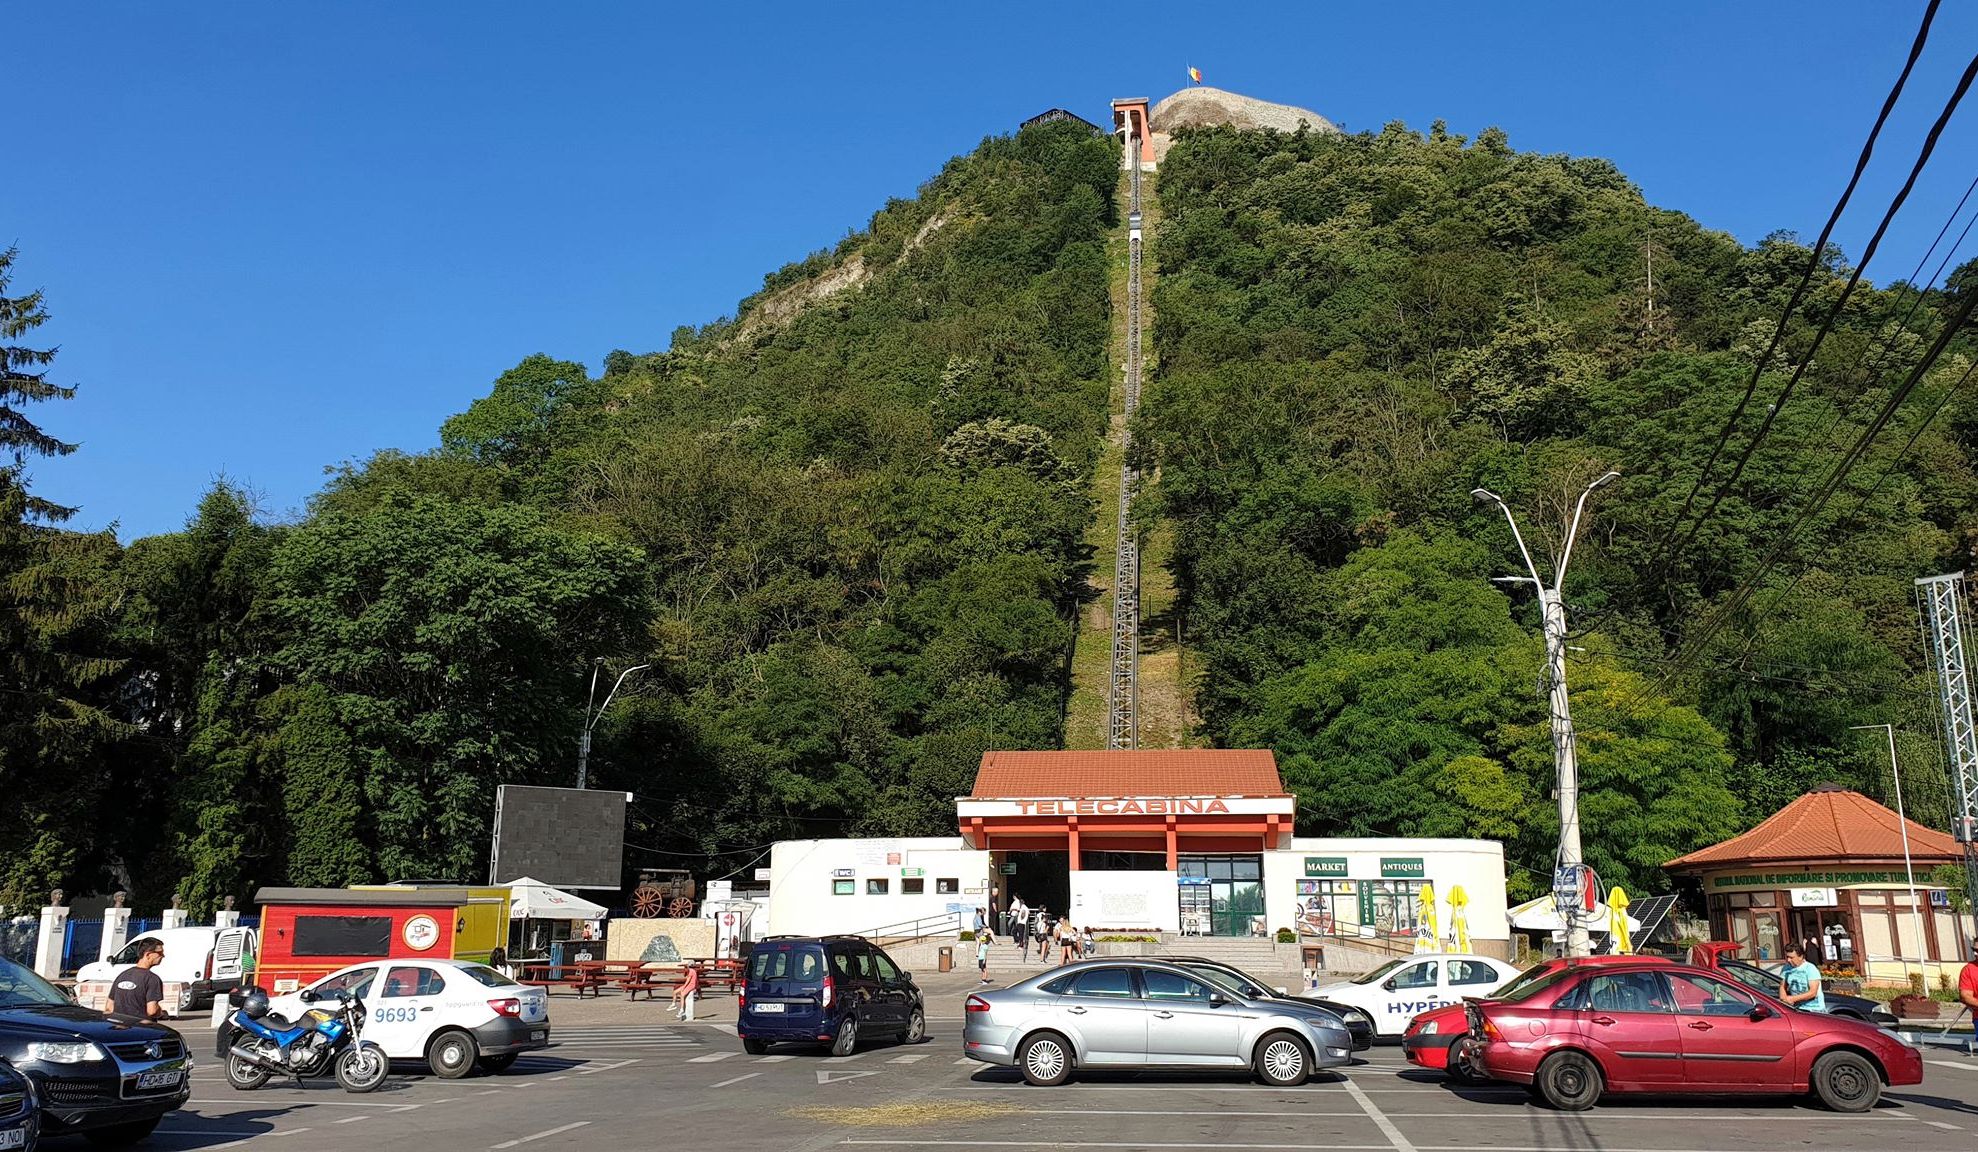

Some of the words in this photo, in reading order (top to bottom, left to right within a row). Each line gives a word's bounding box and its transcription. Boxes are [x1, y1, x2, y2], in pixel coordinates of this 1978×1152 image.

[1015, 799, 1229, 815] TELECABINA
[1306, 862, 1346, 872] MARKET
[1382, 863, 1423, 872] ANTIQUES
[1766, 874, 1776, 884] DE
[1835, 872, 1887, 883] PROMOVARE
[375, 1008, 416, 1023] 9693
